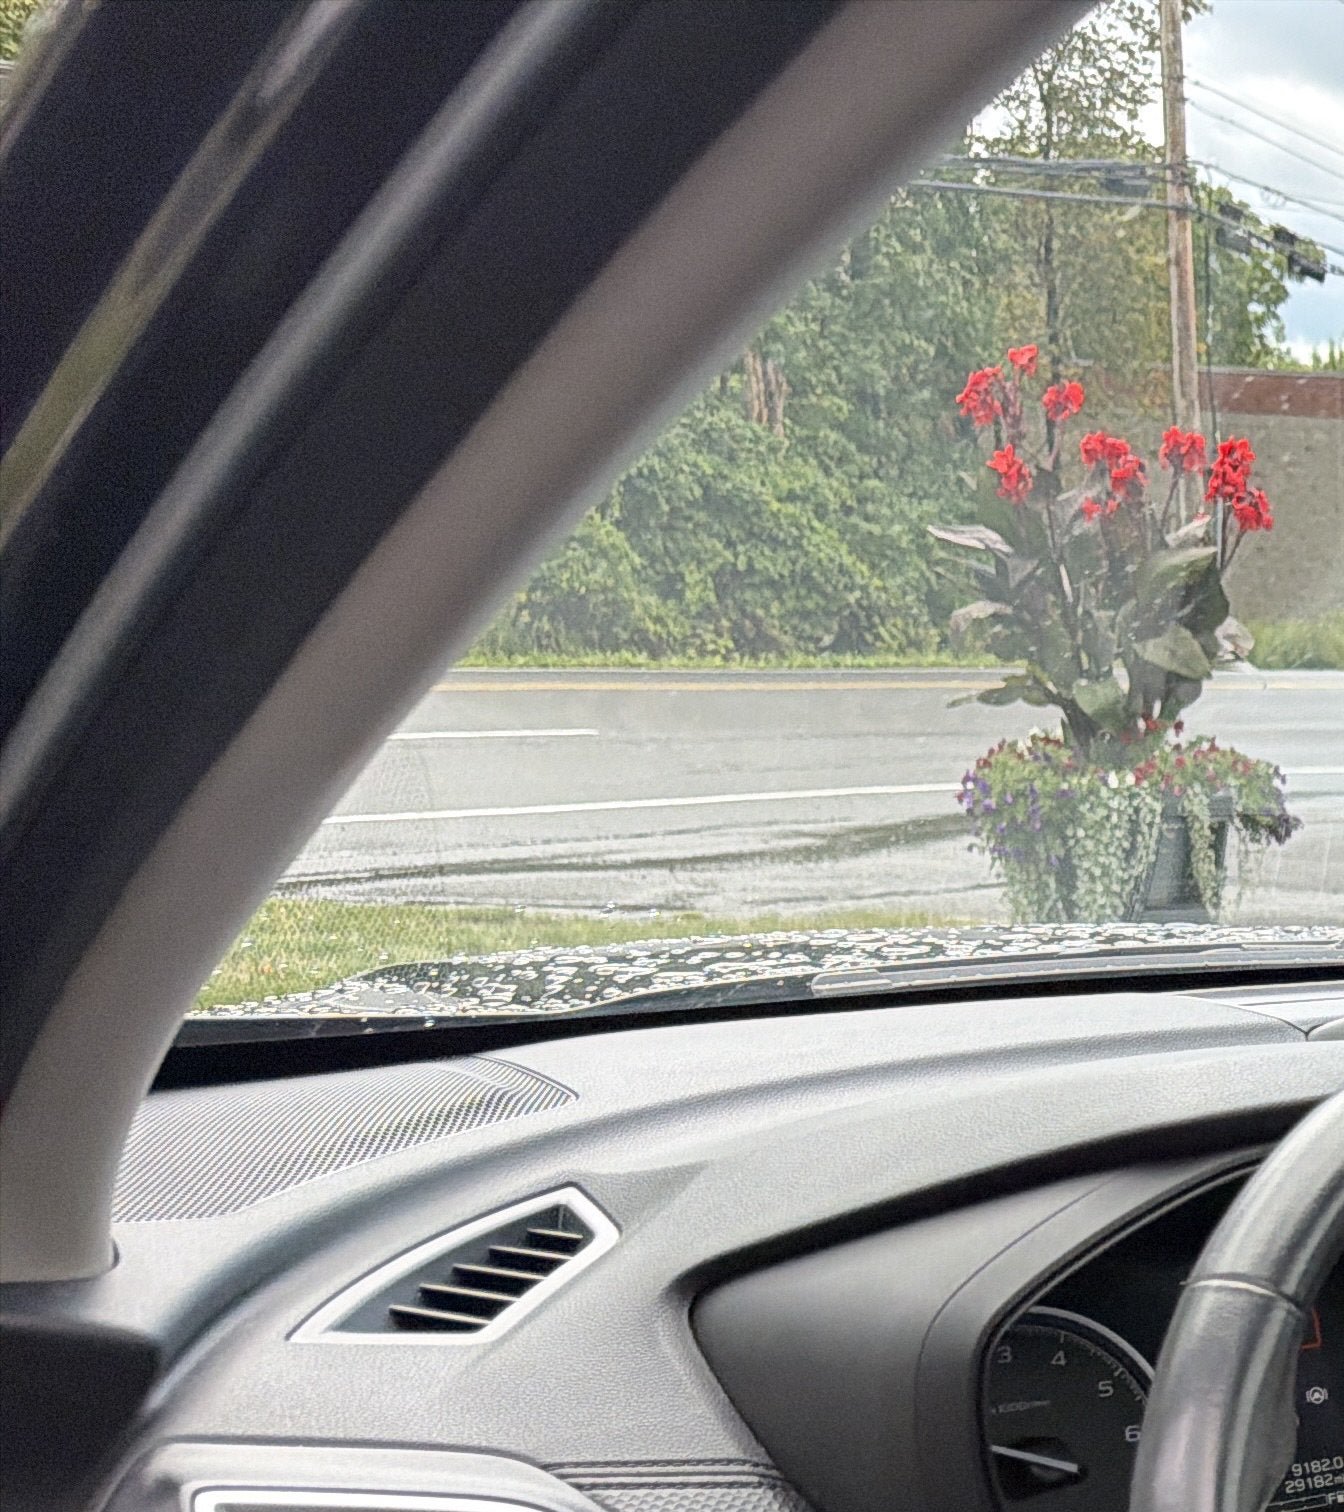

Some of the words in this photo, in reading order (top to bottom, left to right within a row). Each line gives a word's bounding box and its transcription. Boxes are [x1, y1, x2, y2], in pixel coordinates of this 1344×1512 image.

[998, 1345, 1012, 1364] 3
[1051, 1350, 1066, 1366] 4
[1099, 1380, 1114, 1398] 5
[1125, 1425, 1141, 1442] 6
